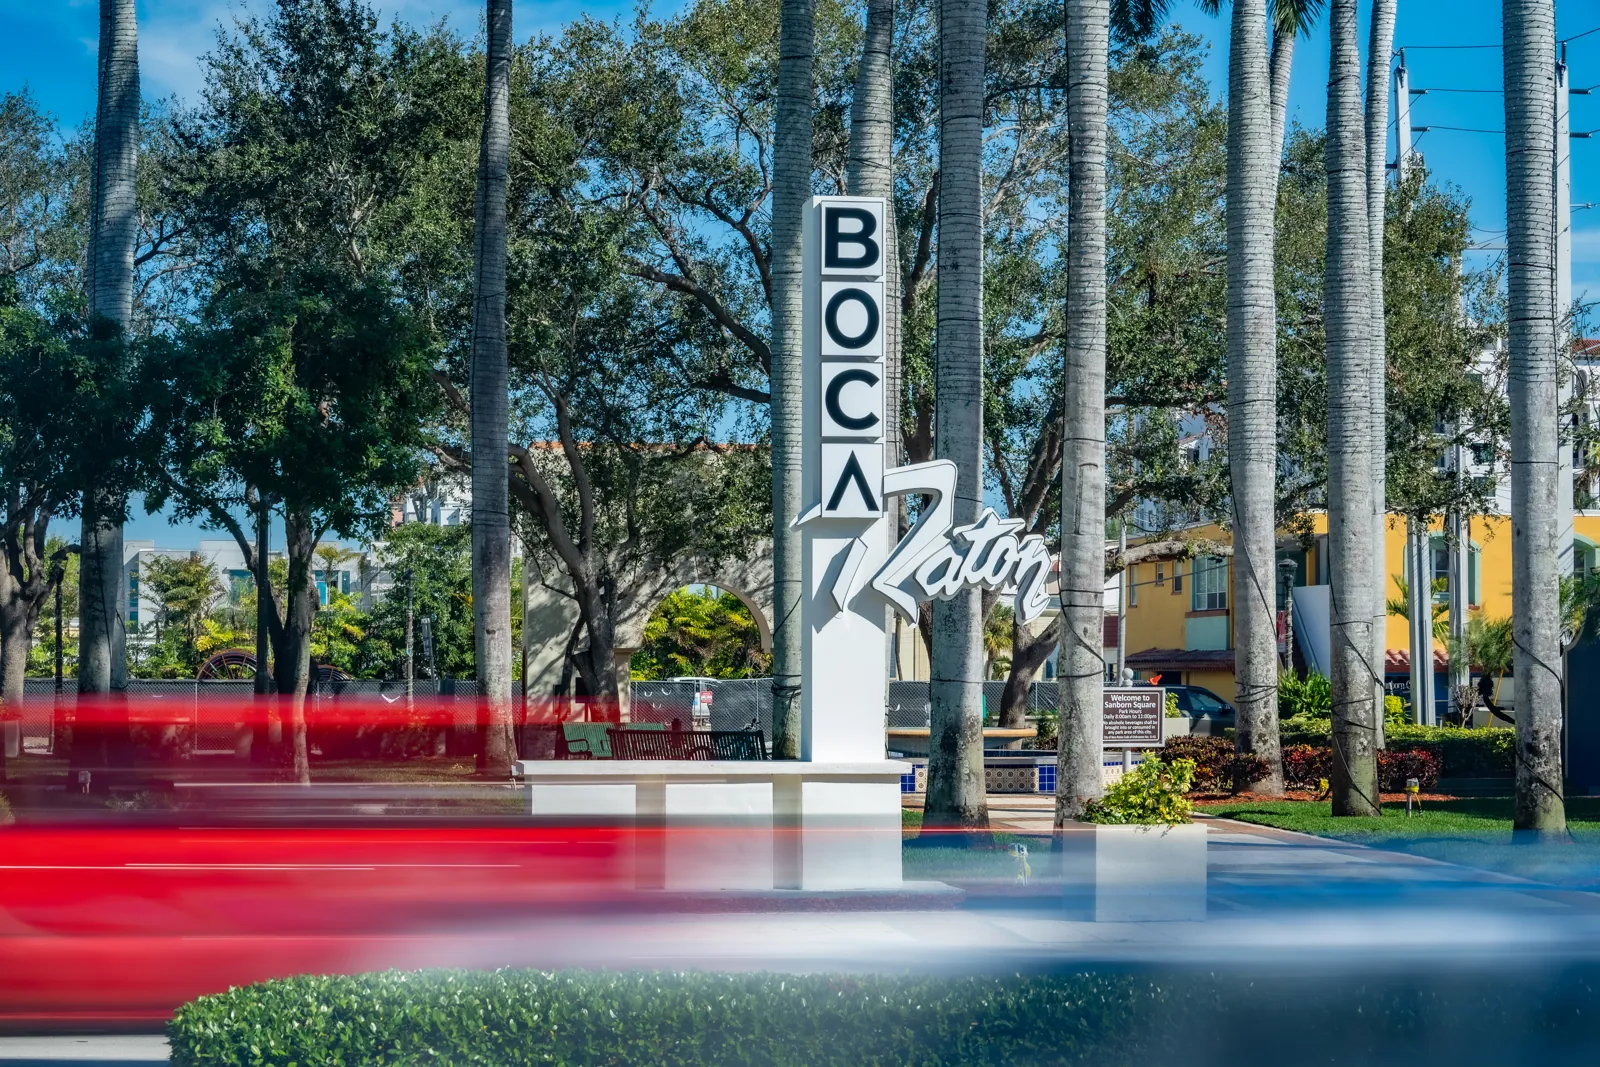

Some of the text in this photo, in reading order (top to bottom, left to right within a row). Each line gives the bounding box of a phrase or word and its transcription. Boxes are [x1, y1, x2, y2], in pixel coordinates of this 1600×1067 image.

[824, 207, 880, 512] BOCA
[828, 459, 1053, 628] Raton
[1133, 701, 1156, 710] Square
